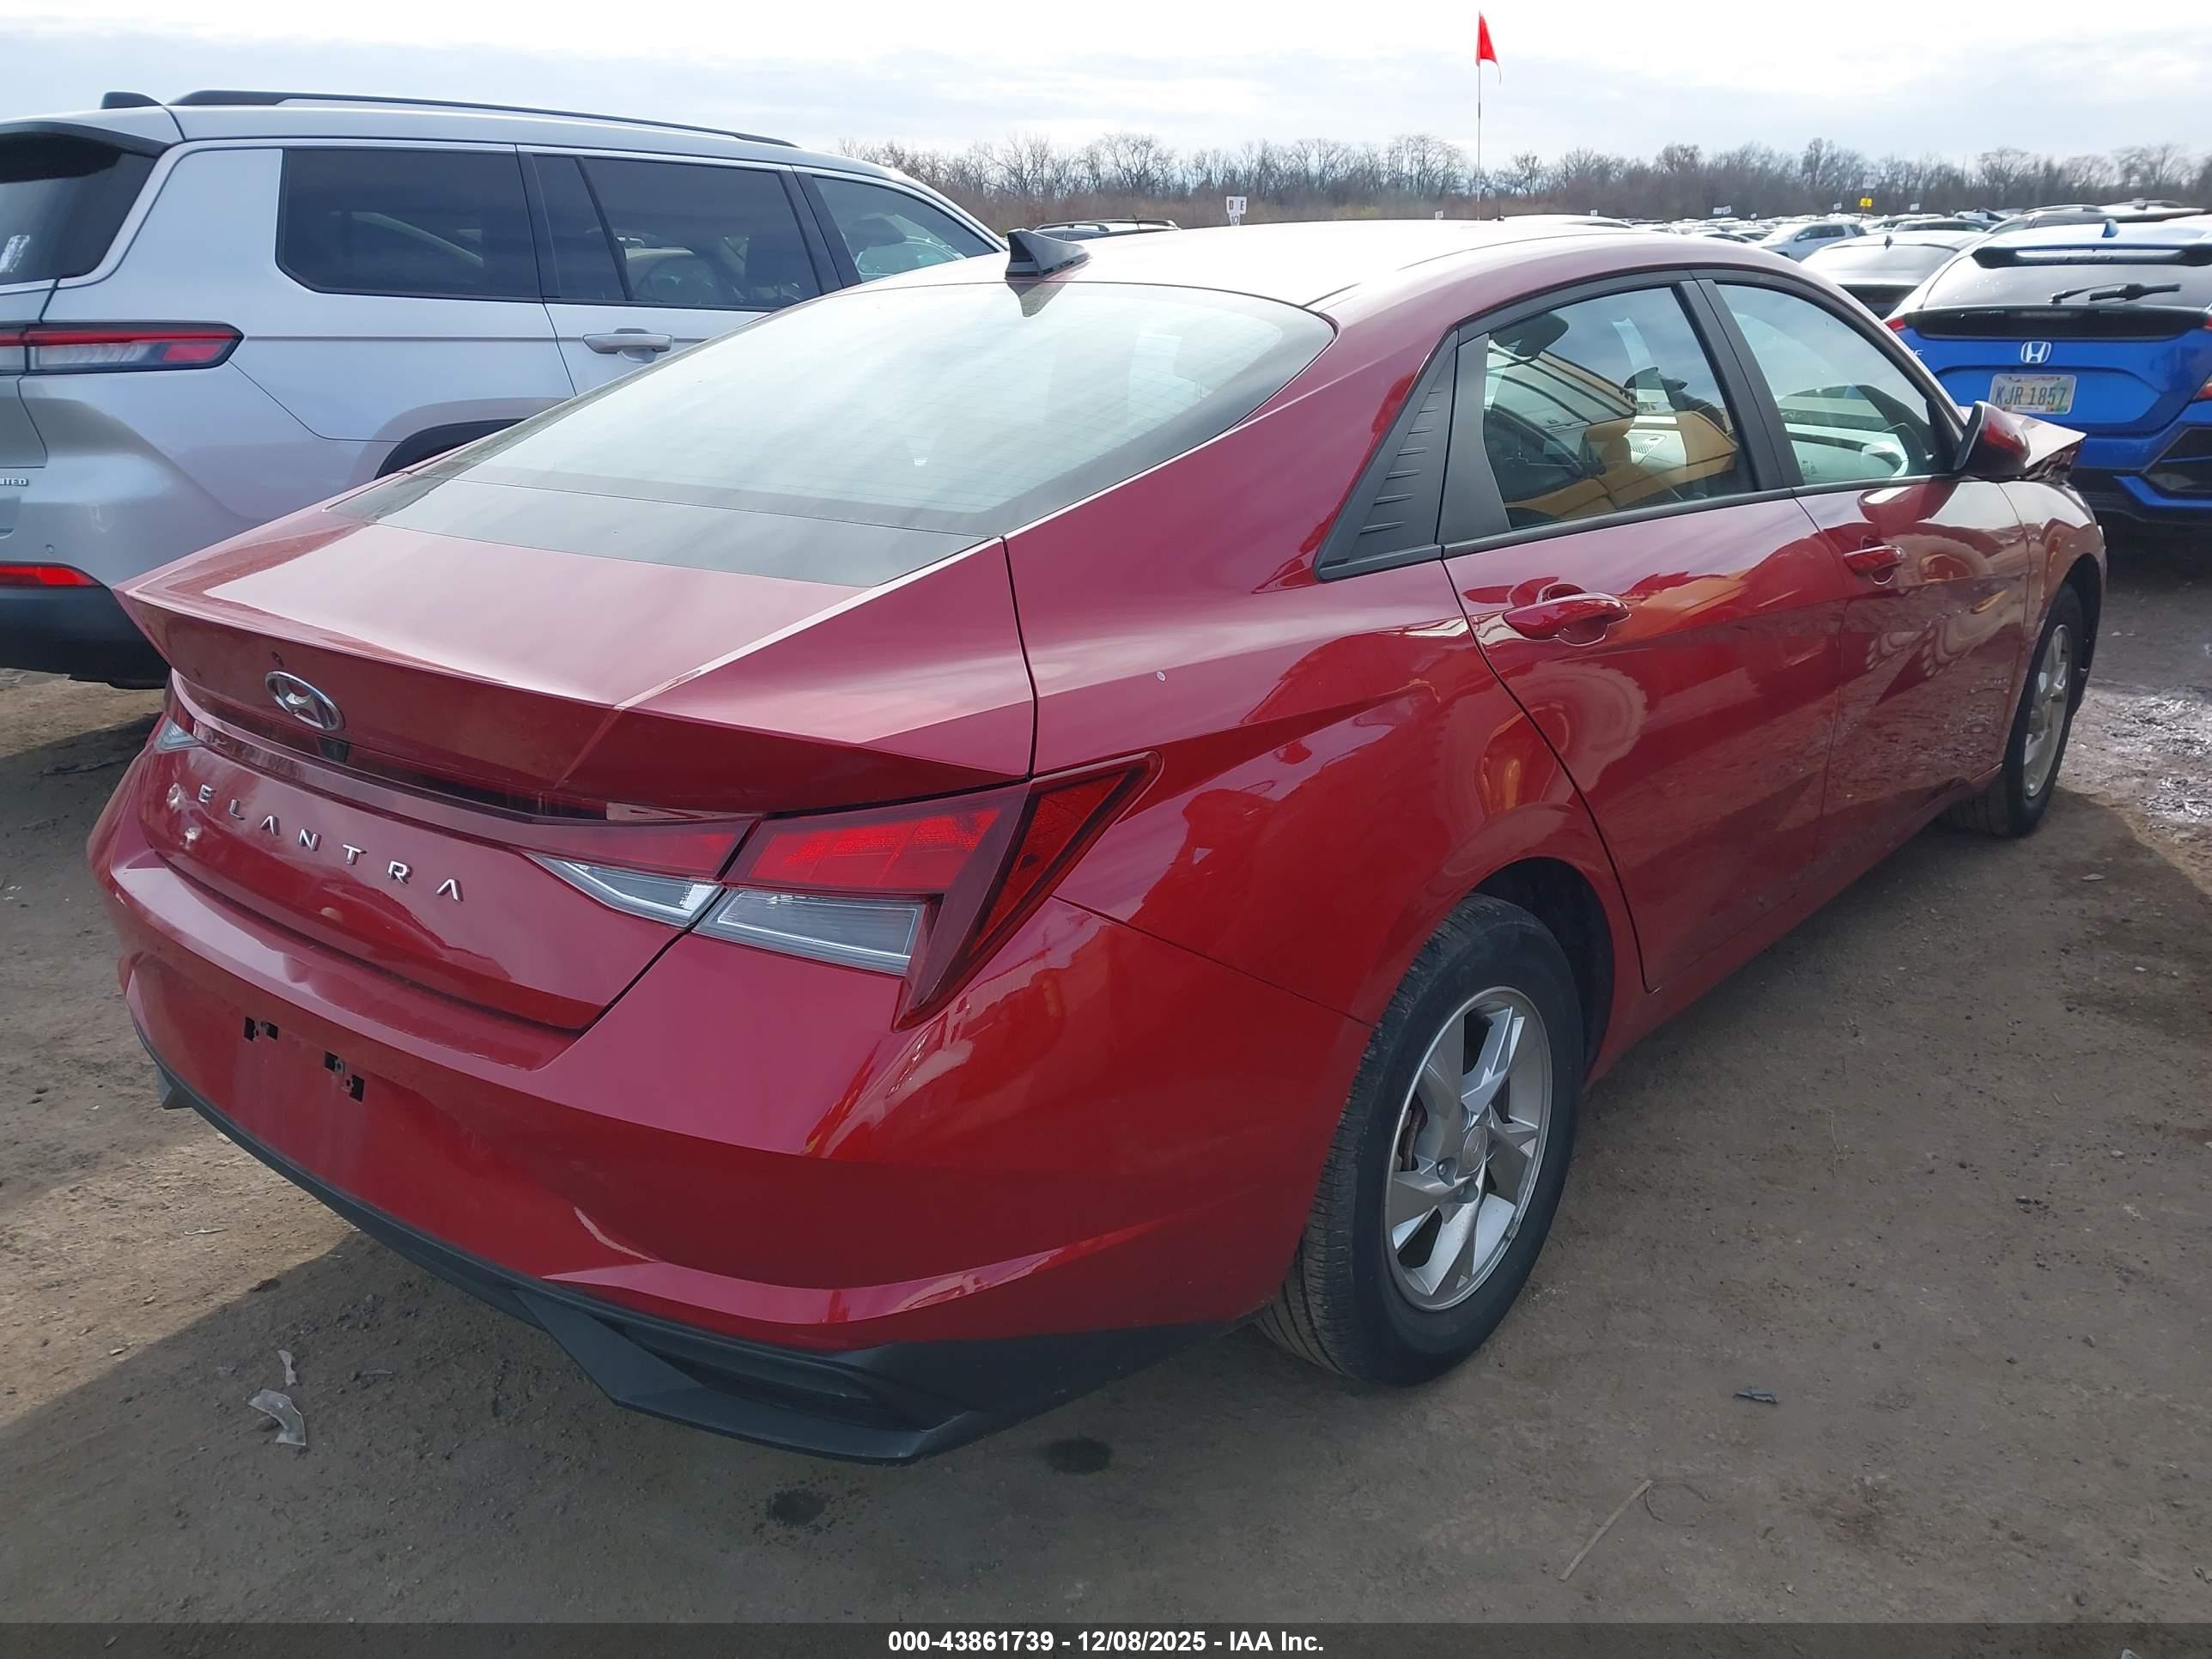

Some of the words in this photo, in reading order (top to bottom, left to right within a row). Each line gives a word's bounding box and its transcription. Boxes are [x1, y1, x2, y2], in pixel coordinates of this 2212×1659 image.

[1995, 386, 2024, 405] KJR
[2027, 386, 2068, 406] 1857
[197, 782, 465, 902] ELANTRA
